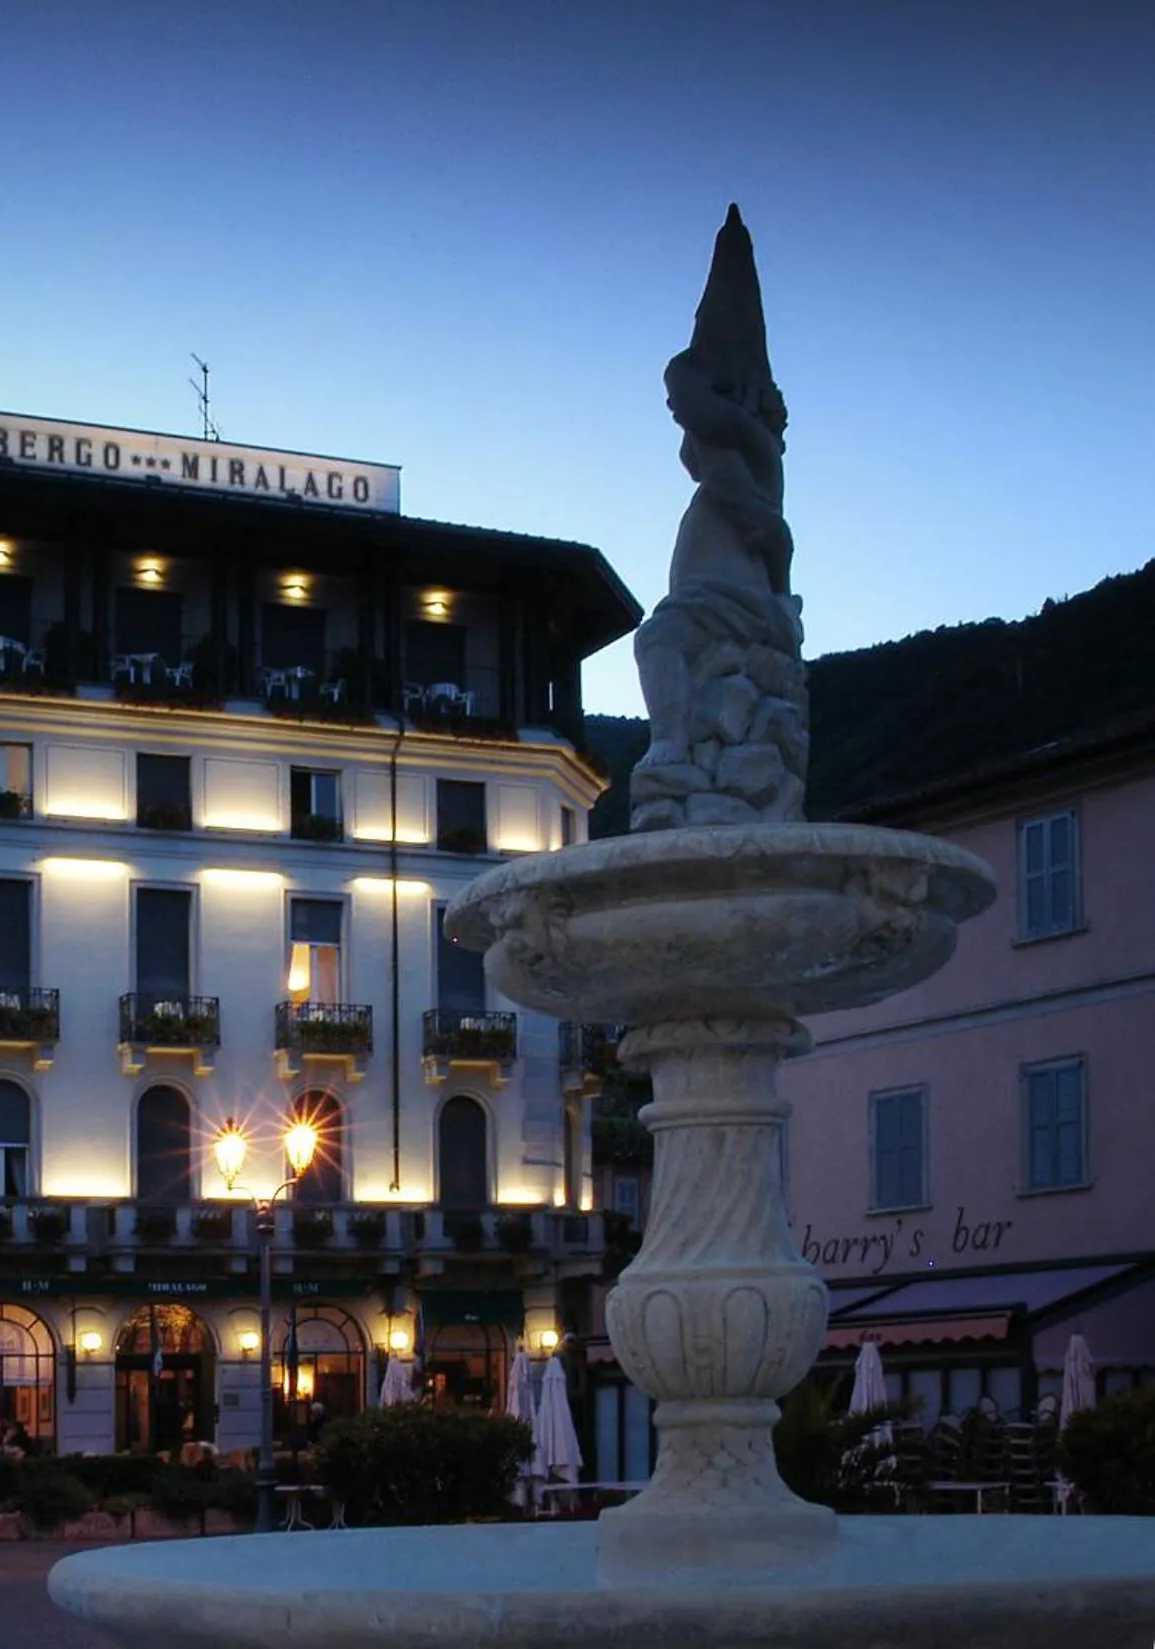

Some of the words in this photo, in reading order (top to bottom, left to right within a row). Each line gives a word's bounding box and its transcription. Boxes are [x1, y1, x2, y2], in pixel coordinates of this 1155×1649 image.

[181, 452, 371, 504] MIRALAGO
[802, 1218, 925, 1275] barry's
[952, 1207, 1013, 1254] bar
